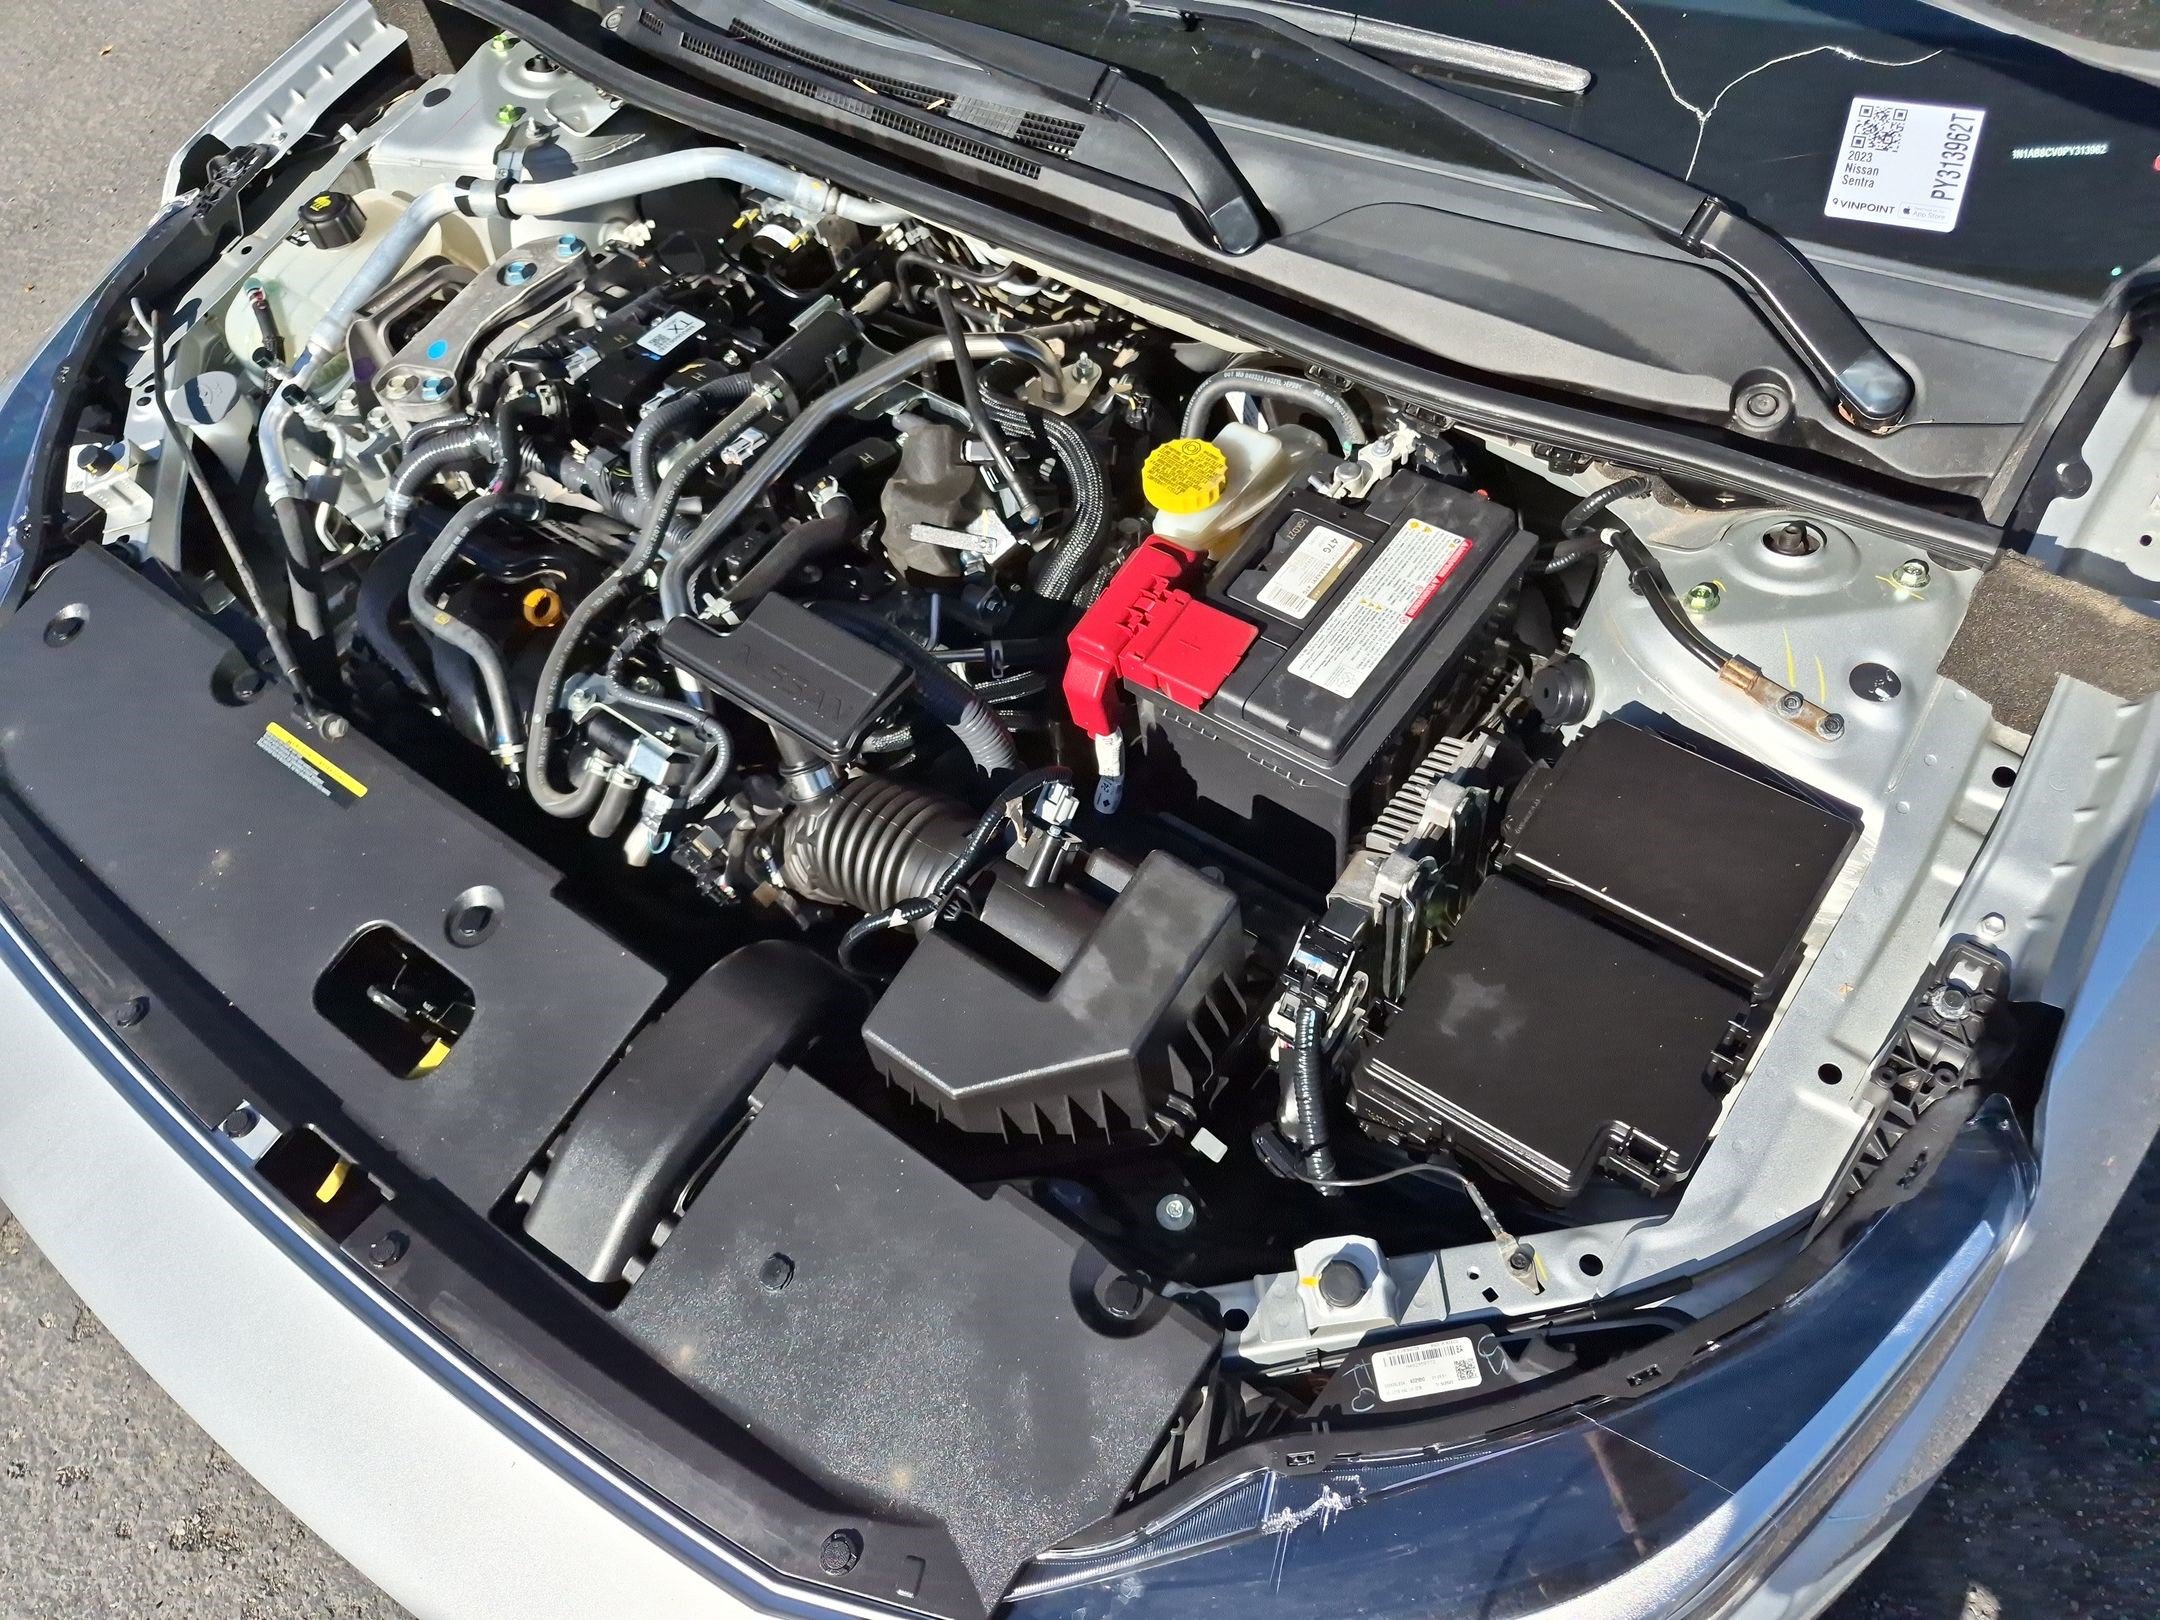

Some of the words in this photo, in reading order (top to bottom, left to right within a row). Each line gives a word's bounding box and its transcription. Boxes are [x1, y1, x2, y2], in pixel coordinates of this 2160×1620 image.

[1847, 150, 1873, 163] 2023
[1930, 112, 1976, 201] PY313962T
[1844, 162, 1880, 176] Nissan
[1841, 174, 1875, 188] Sentra
[1840, 199, 1895, 214] VINPOINT
[1322, 537, 1338, 553] 47G
